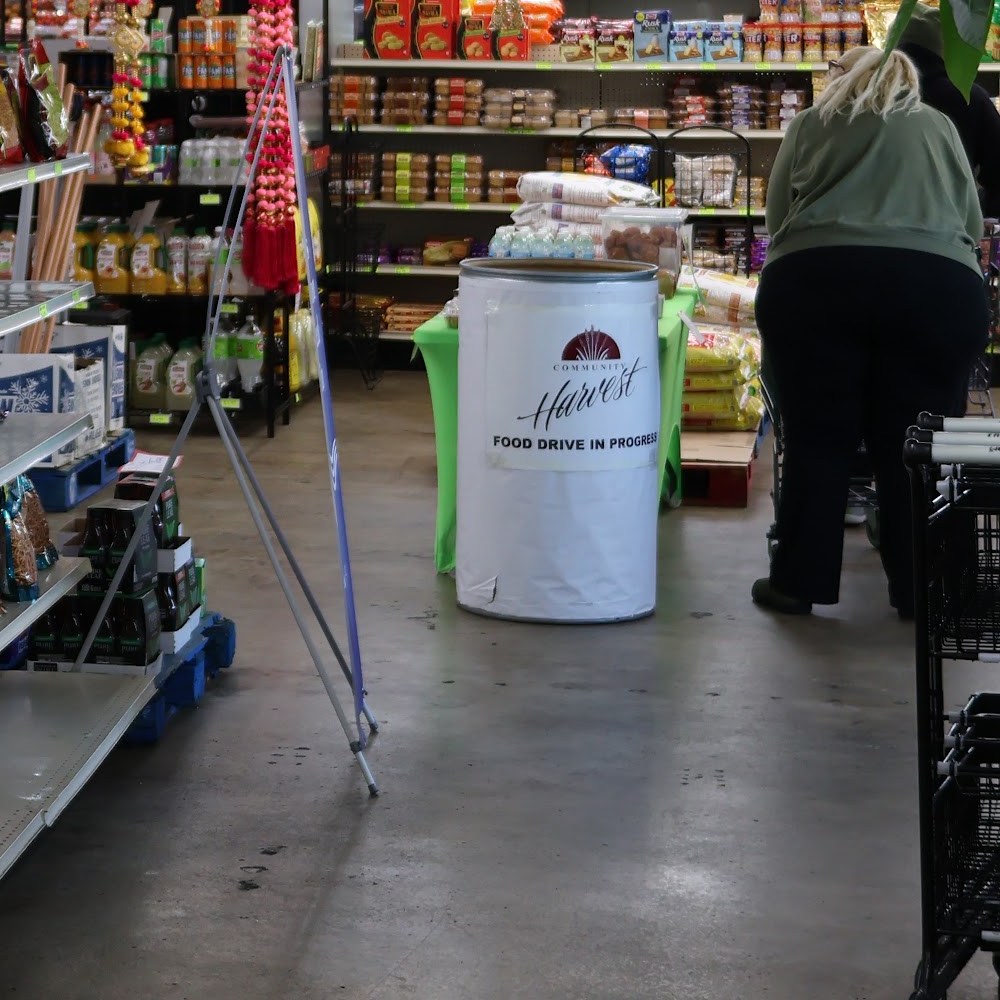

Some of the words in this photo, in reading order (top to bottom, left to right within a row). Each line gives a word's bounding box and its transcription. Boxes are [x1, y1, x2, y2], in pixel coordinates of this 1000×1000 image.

[642, 19, 660, 28] Rusk
[553, 363, 627, 372] COMMUNITY
[516, 356, 648, 432] Harvest
[493, 436, 532, 449] FOOD
[537, 439, 585, 450] DRIVE
[590, 438, 605, 450] IN
[609, 432, 658, 450] PROGRESS
